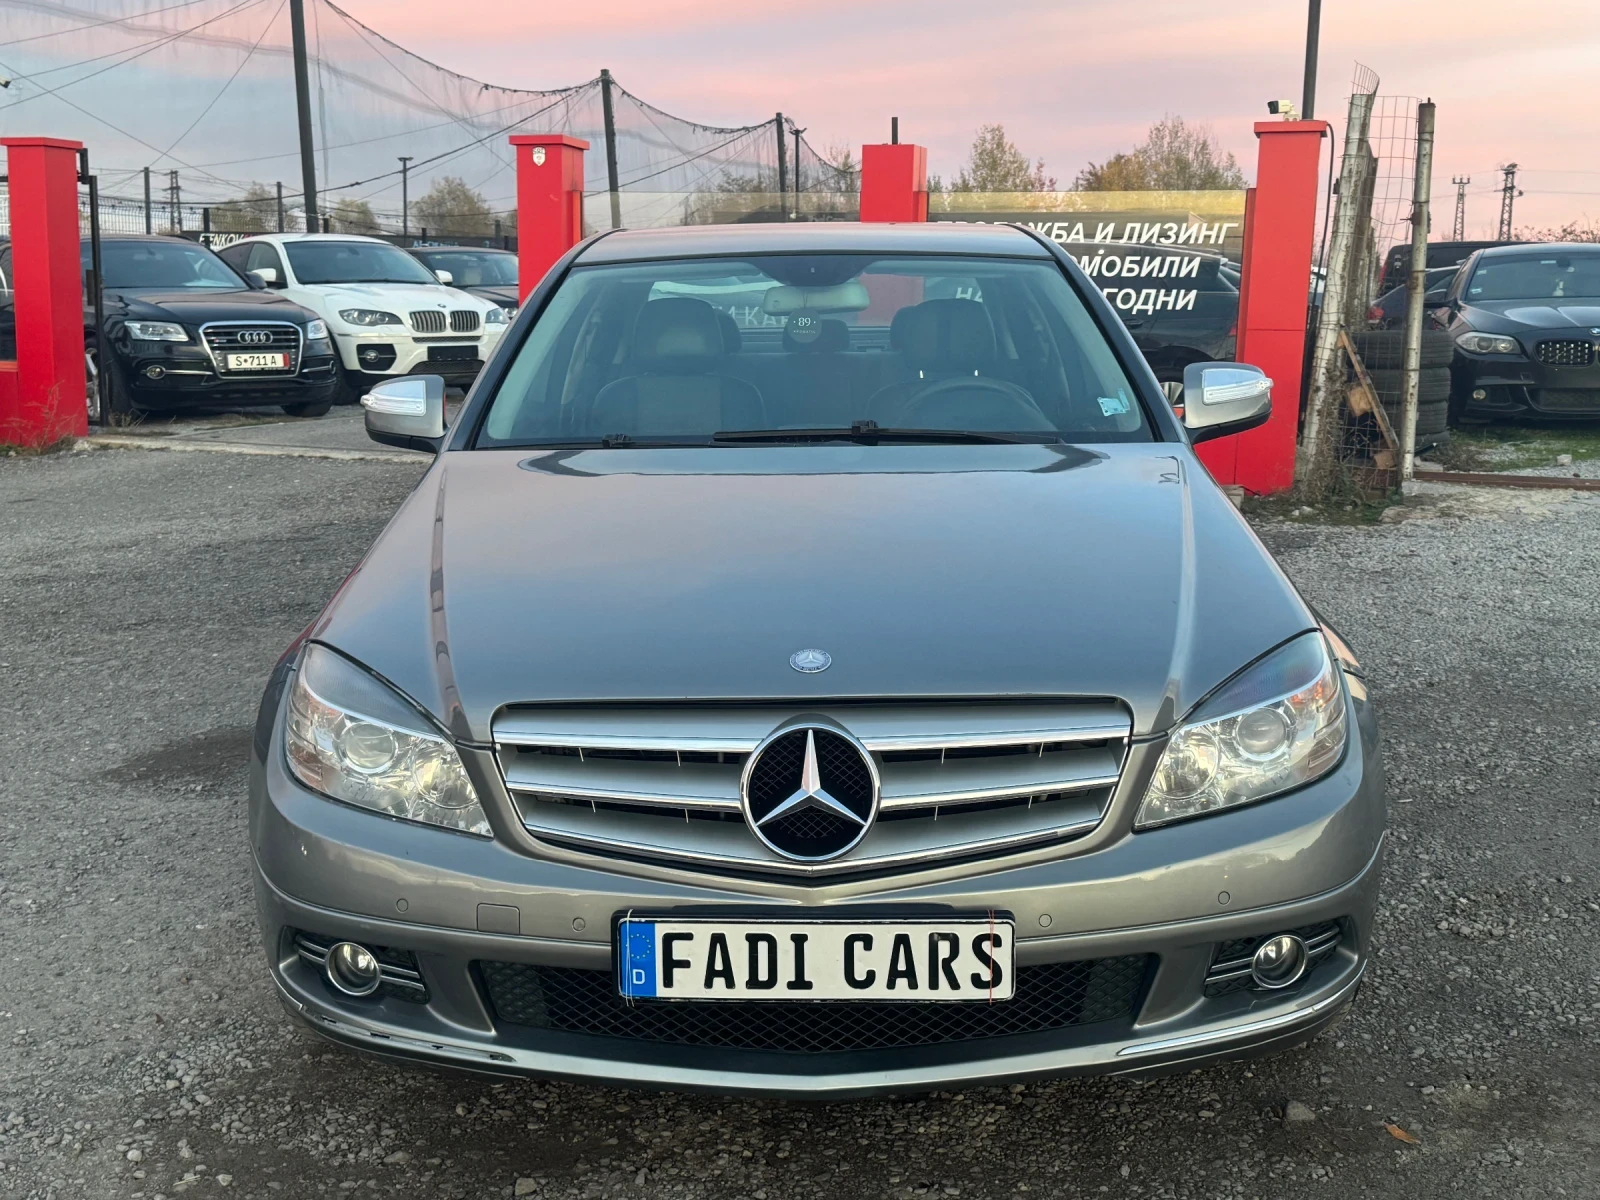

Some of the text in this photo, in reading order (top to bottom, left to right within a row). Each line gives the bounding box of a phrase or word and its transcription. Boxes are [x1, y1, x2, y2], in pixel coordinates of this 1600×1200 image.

[1093, 222, 1114, 244] И
[1119, 221, 1239, 245] ЛИЗИНГ
[1070, 254, 1202, 278] МОБИЛИ
[1102, 288, 1198, 315] ГОДНИ
[798, 317, 811, 327] 89
[632, 932, 1004, 990] D FADI CARS
